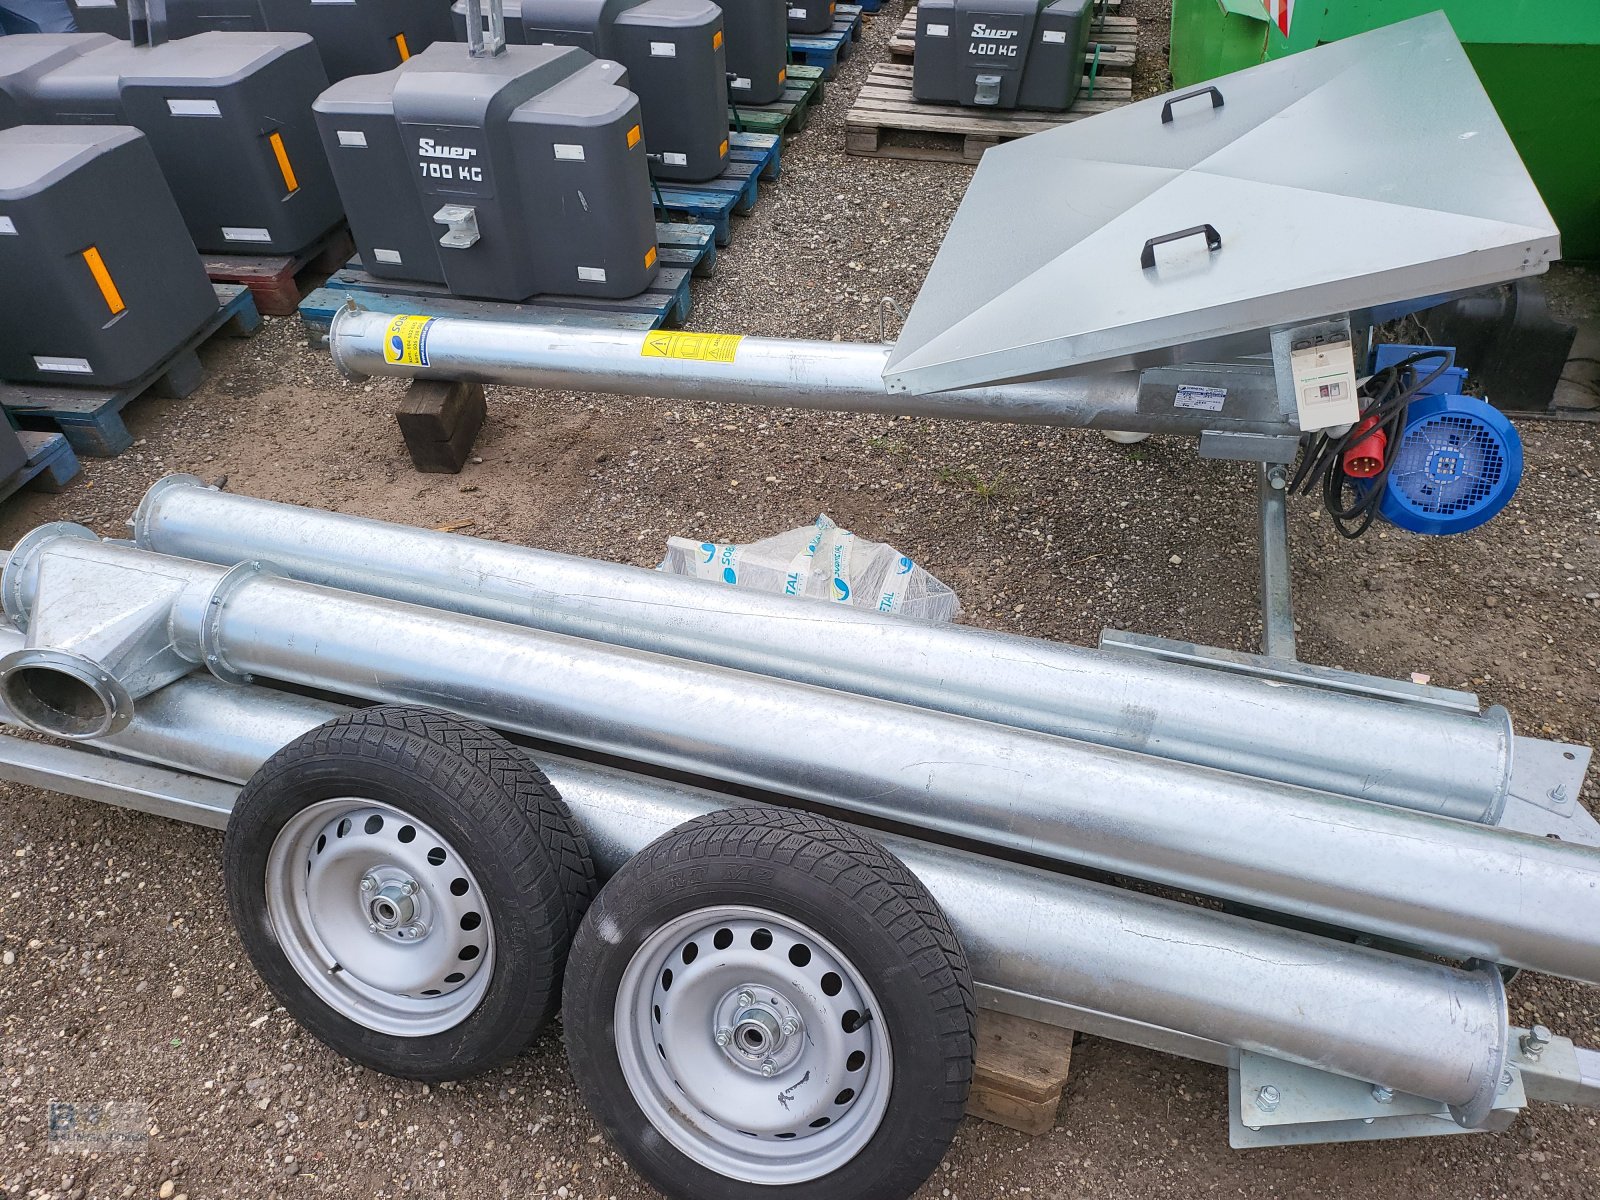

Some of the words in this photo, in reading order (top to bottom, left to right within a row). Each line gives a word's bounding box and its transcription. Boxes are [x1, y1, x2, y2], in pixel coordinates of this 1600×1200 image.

[971, 23, 1018, 39] Suer
[968, 42, 996, 55] 400
[998, 45, 1018, 57] KG
[419, 138, 477, 160] Suer
[420, 162, 453, 179] 700
[459, 166, 482, 182] KG
